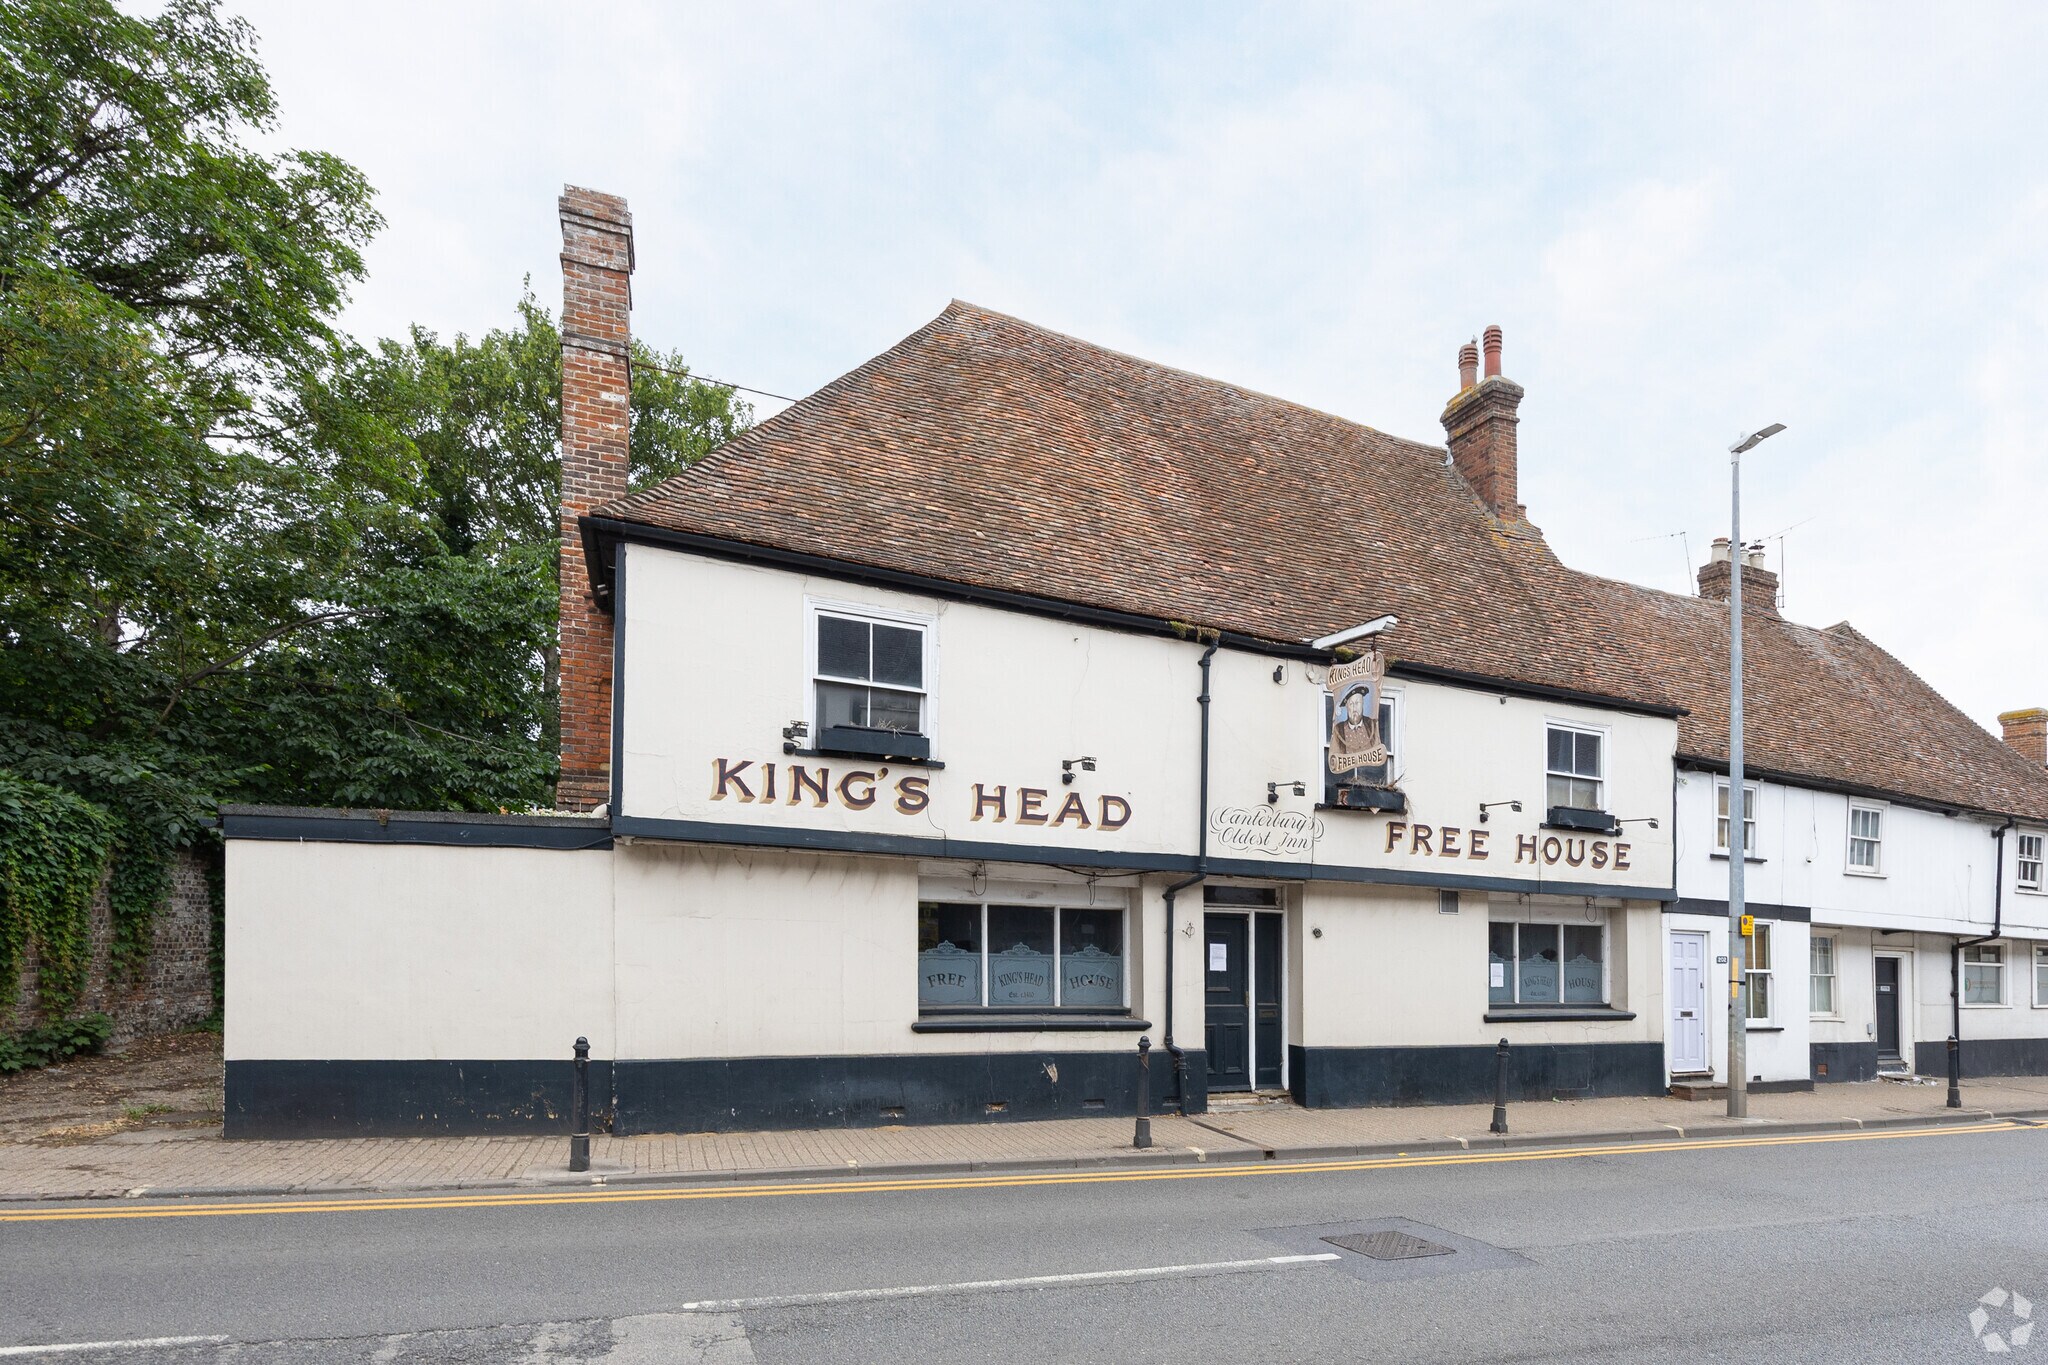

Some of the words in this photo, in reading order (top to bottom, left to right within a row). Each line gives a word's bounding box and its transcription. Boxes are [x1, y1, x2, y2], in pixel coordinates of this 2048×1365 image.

[1352, 656, 1371, 677] HEAD
[1337, 756, 1356, 770] FREE
[1358, 747, 1382, 763] HOUSE
[709, 757, 930, 816] KING'S
[970, 783, 1132, 832] HEAD
[1218, 806, 1315, 835] Canterbury's
[1221, 826, 1272, 847] Oldest
[1278, 831, 1309, 850] Inn
[1384, 821, 1490, 861] FREE
[1514, 833, 1632, 872] HOUSE
[926, 972, 967, 988] FREE
[998, 972, 1023, 987] KING'S
[1024, 972, 1044, 987] HEAD
[1069, 974, 1114, 990] HOUSE
[1568, 977, 1597, 990] HOUSE
